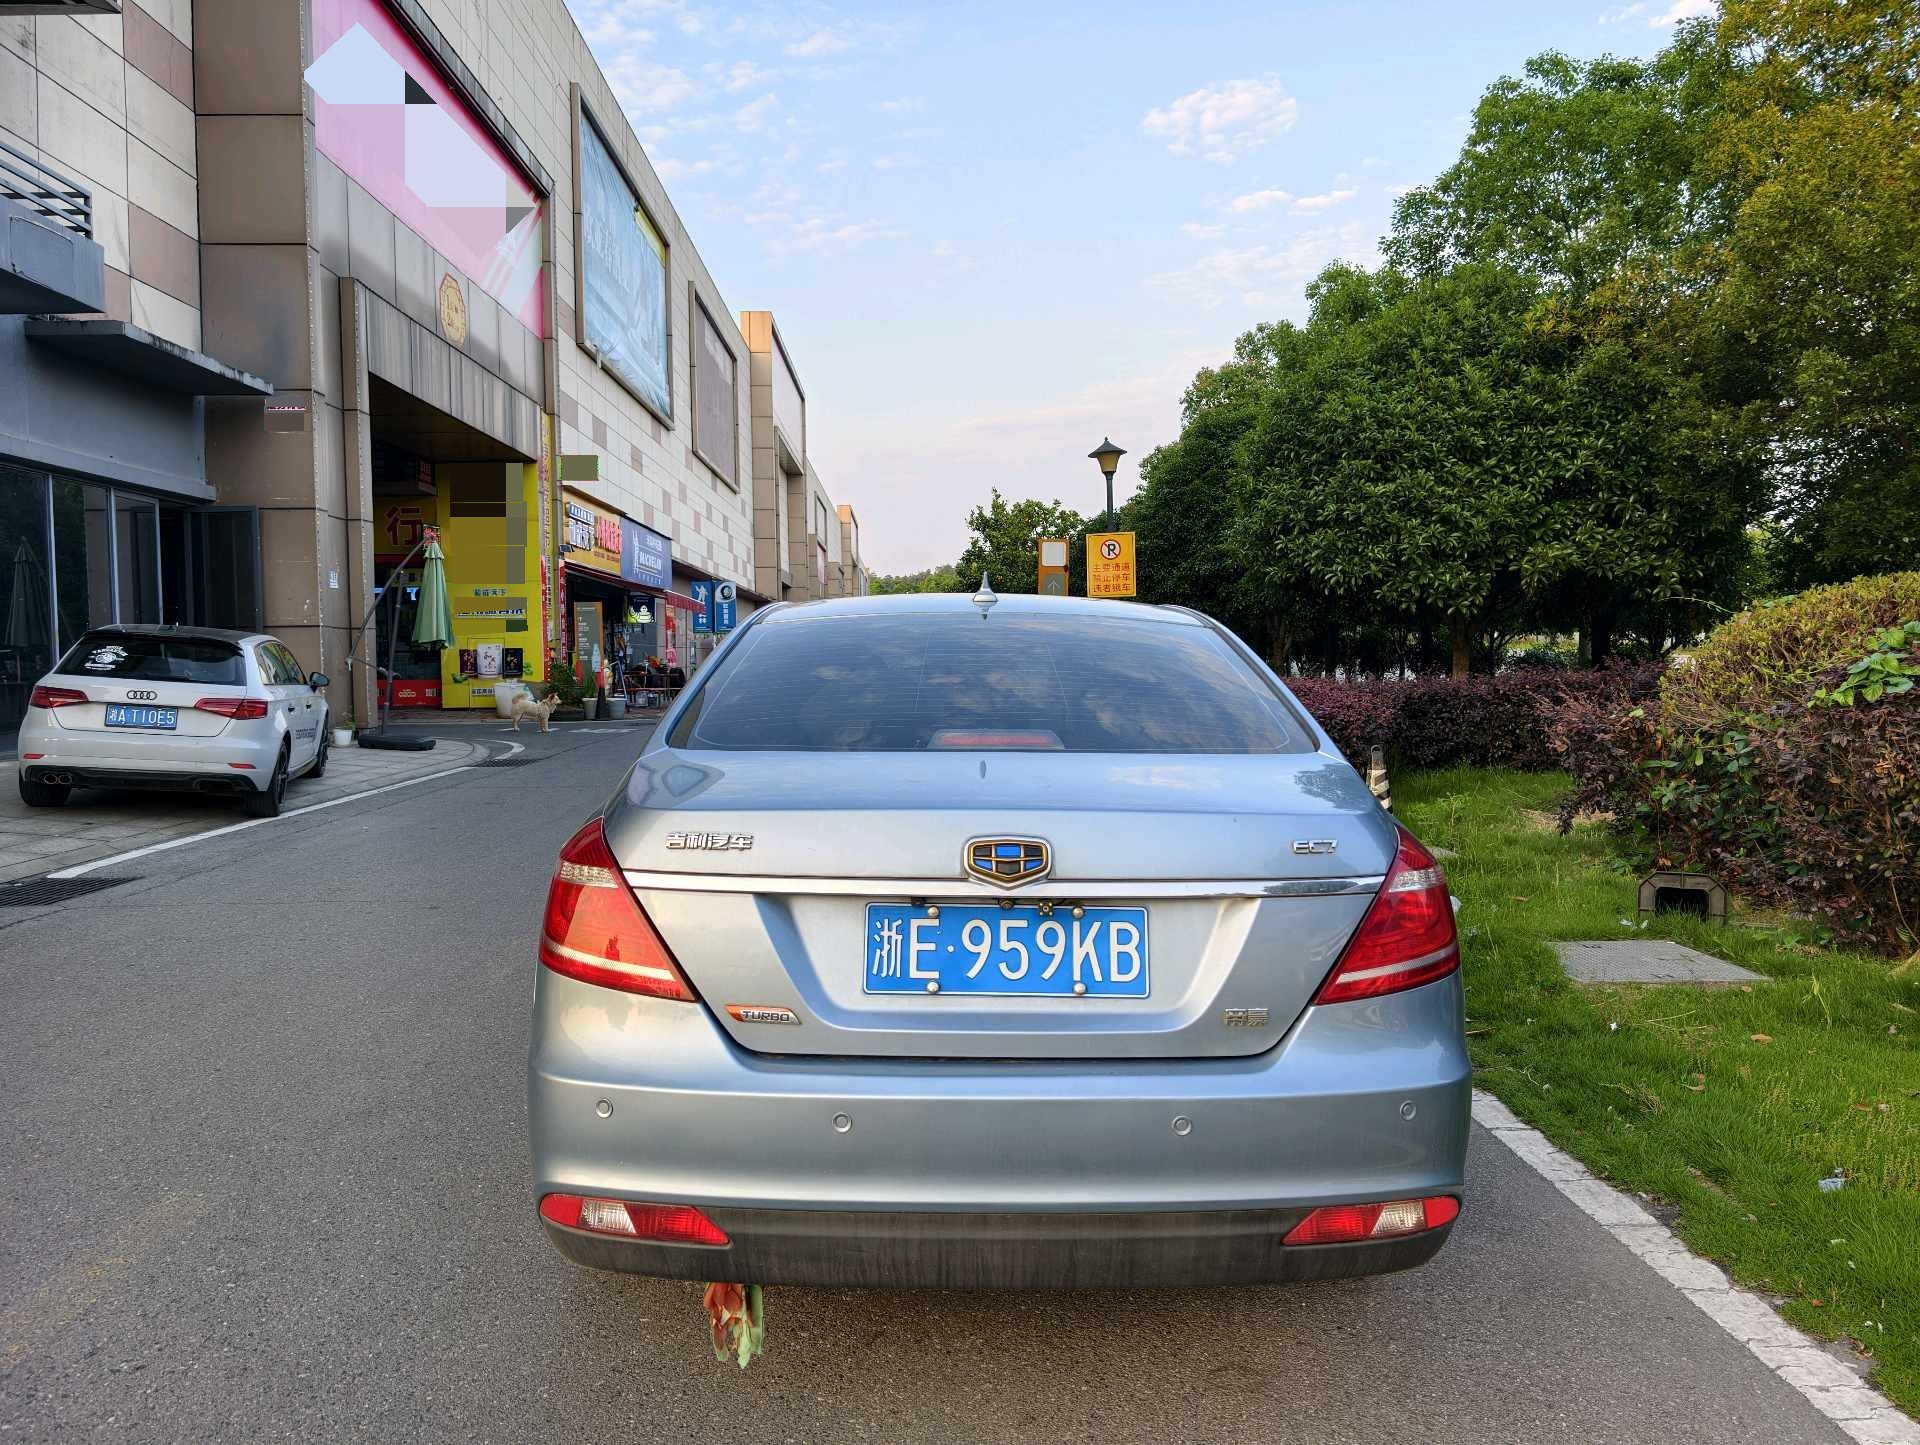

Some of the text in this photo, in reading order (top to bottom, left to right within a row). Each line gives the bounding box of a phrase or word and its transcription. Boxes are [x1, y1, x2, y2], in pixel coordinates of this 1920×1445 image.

[1093, 562, 1130, 572] 主要通道
[666, 832, 753, 850] 吉利汽车
[1293, 839, 1338, 855] EC7
[742, 1010, 790, 1022] TURBO
